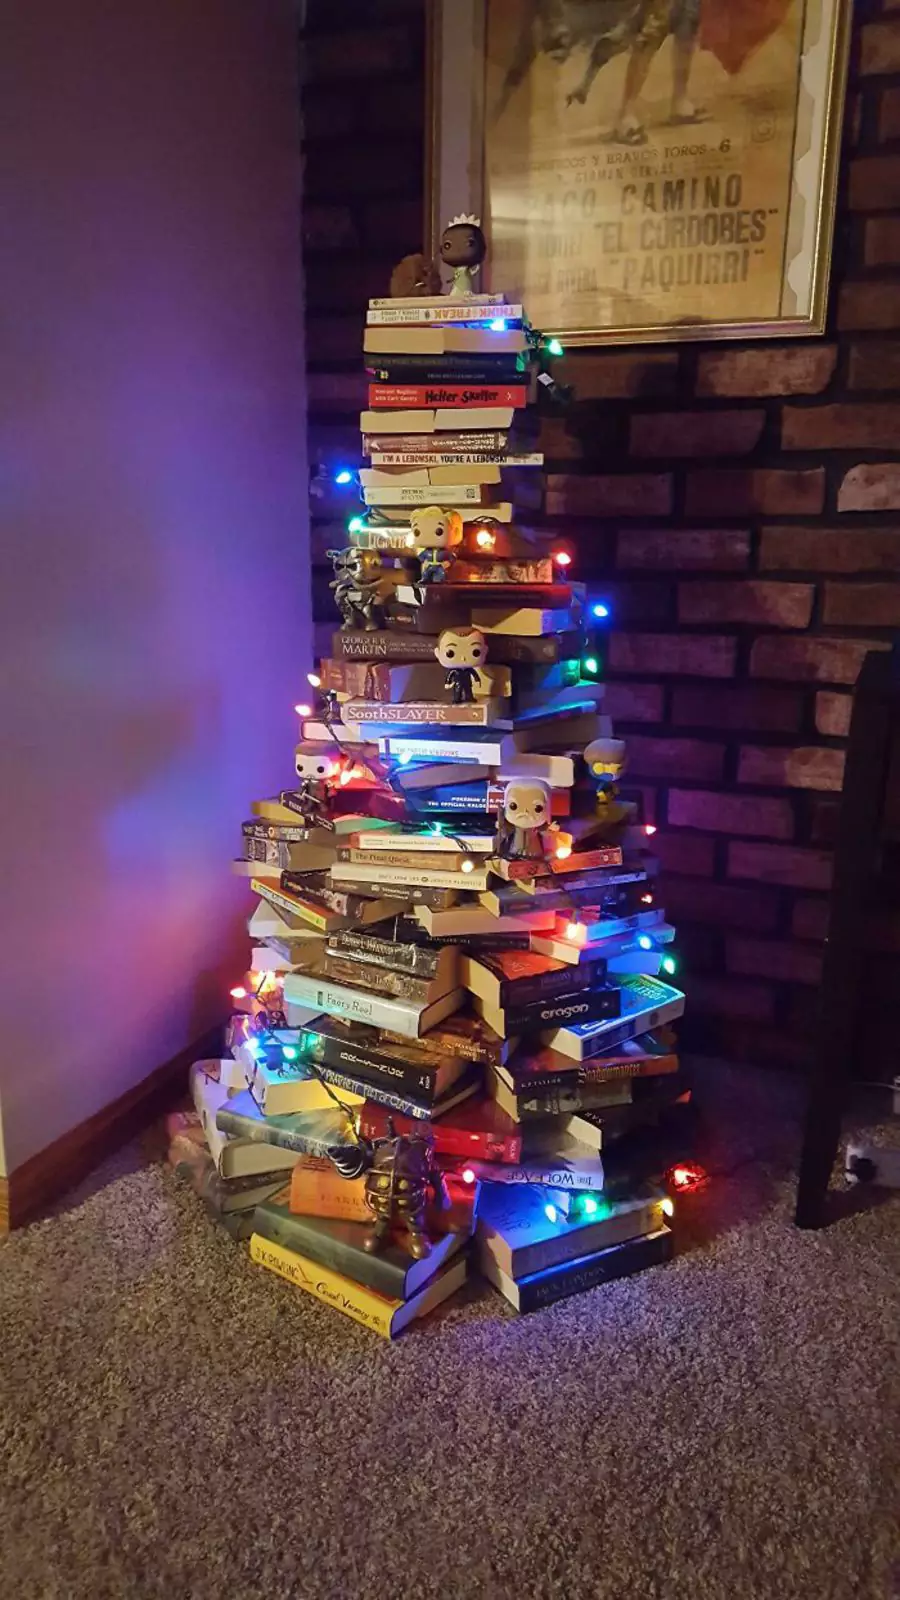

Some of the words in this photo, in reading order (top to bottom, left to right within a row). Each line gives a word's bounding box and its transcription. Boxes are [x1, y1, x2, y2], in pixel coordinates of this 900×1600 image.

[664, 144, 707, 159] TOROS
[719, 139, 732, 153] 6
[620, 173, 744, 216] CAMINO
[434, 307, 471, 319] FREAK
[479, 306, 516, 318] THINK
[425, 391, 458, 404] Helter
[461, 389, 499, 402] Skelter
[395, 455, 400, 463] A
[440, 454, 465, 463] YOU'RE
[466, 454, 471, 463] A
[472, 454, 508, 463] LEBOWSKI
[341, 636, 372, 646] GEORGE
[342, 645, 389, 656] MARTIN
[355, 852, 368, 861] The
[327, 993, 351, 1012] Faery
[352, 1001, 373, 1016] Reel
[339, 1051, 405, 1079] BRISINGR
